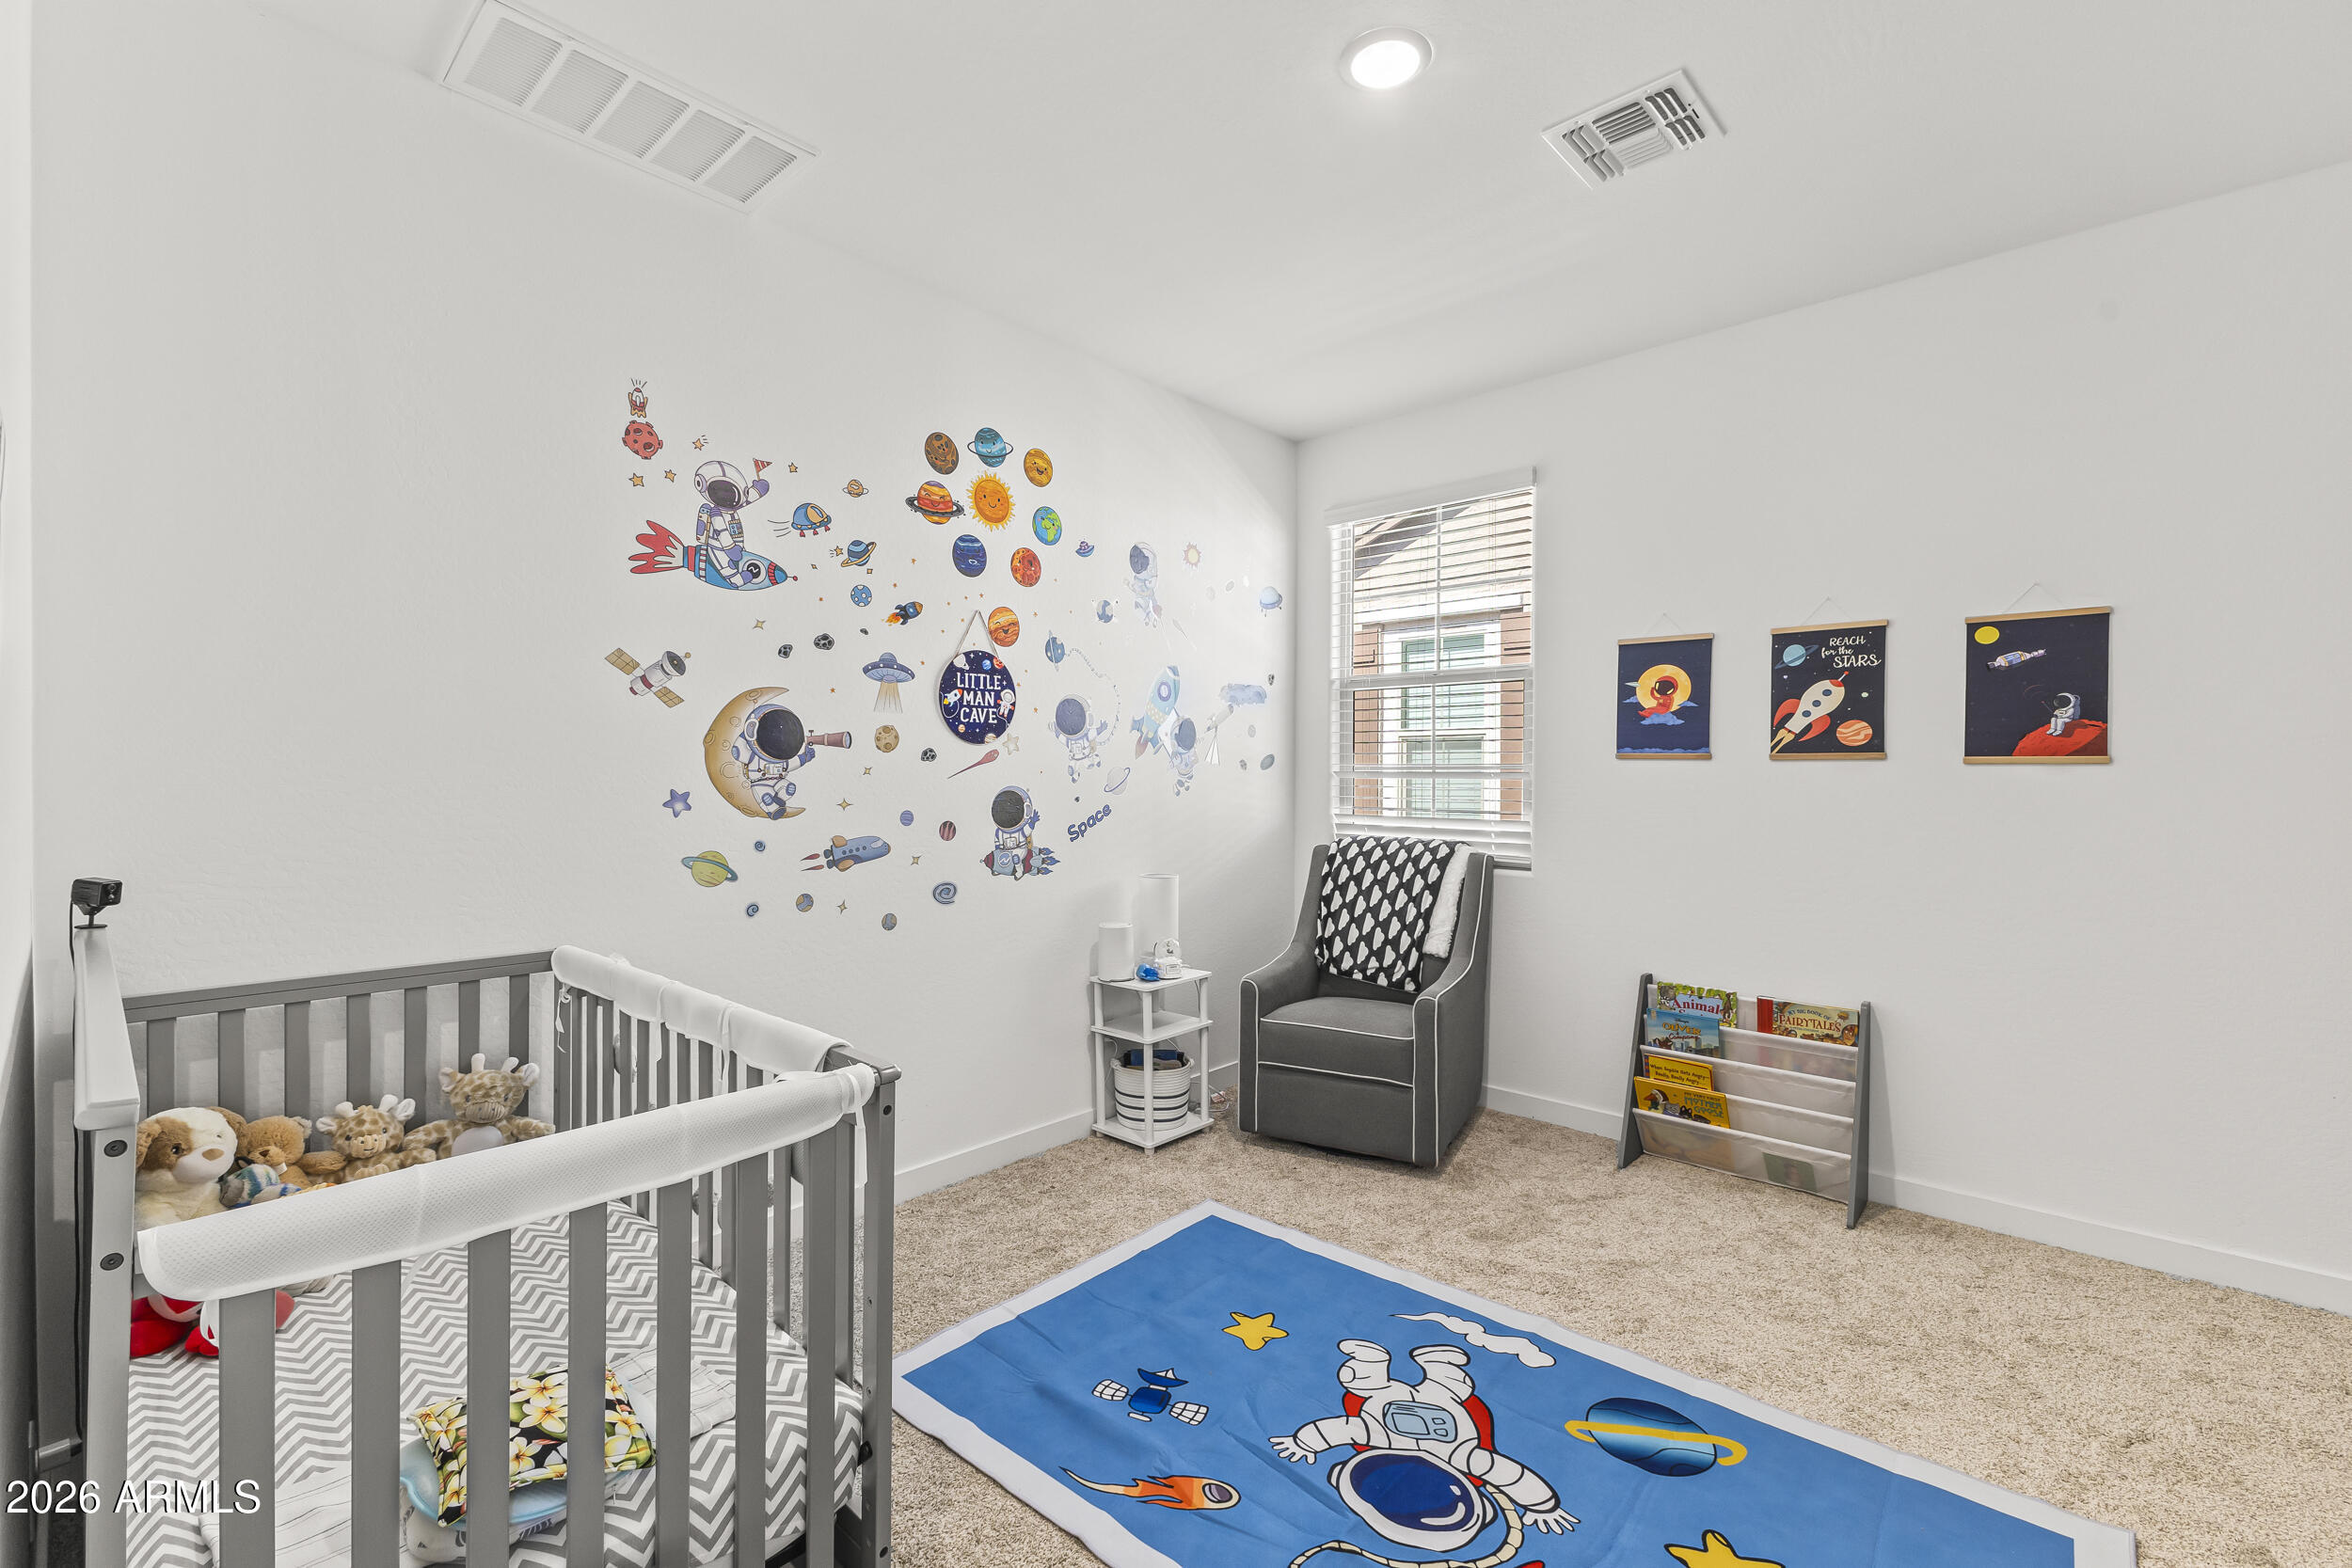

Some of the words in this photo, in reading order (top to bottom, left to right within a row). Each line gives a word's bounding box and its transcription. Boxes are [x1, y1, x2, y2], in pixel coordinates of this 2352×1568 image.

[1829, 636, 1867, 646] REACH
[1821, 647, 1837, 658] for
[1838, 646, 1854, 656] the
[1833, 654, 1883, 668] STARS
[956, 672, 1002, 690] LITTLE
[962, 690, 995, 707] MAN
[960, 707, 998, 724] CAVE
[1067, 803, 1112, 843] Space
[1672, 998, 1721, 1015] Animal
[1662, 1022, 1702, 1036] OLIVER
[1778, 1014, 1841, 1032] FAIRYTALES
